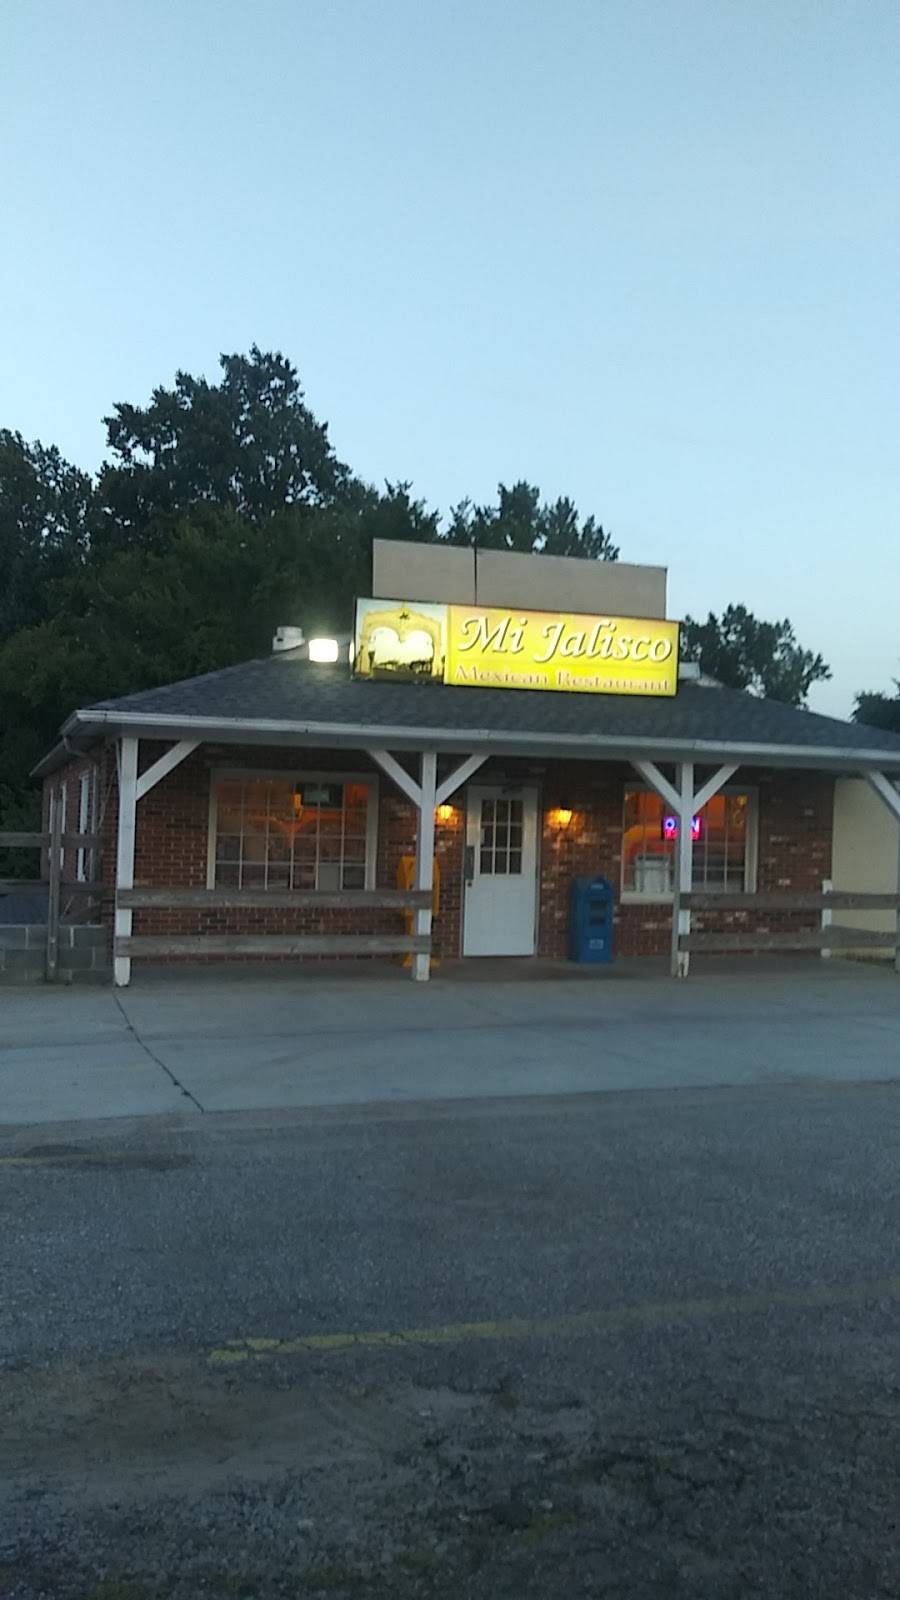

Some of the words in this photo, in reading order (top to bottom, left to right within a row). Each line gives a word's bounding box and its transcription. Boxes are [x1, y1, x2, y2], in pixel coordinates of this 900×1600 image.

[458, 615, 528, 654] Mi
[534, 622, 674, 663] Jalisco
[456, 665, 548, 686] Mexican
[556, 671, 670, 692] Restaurant
